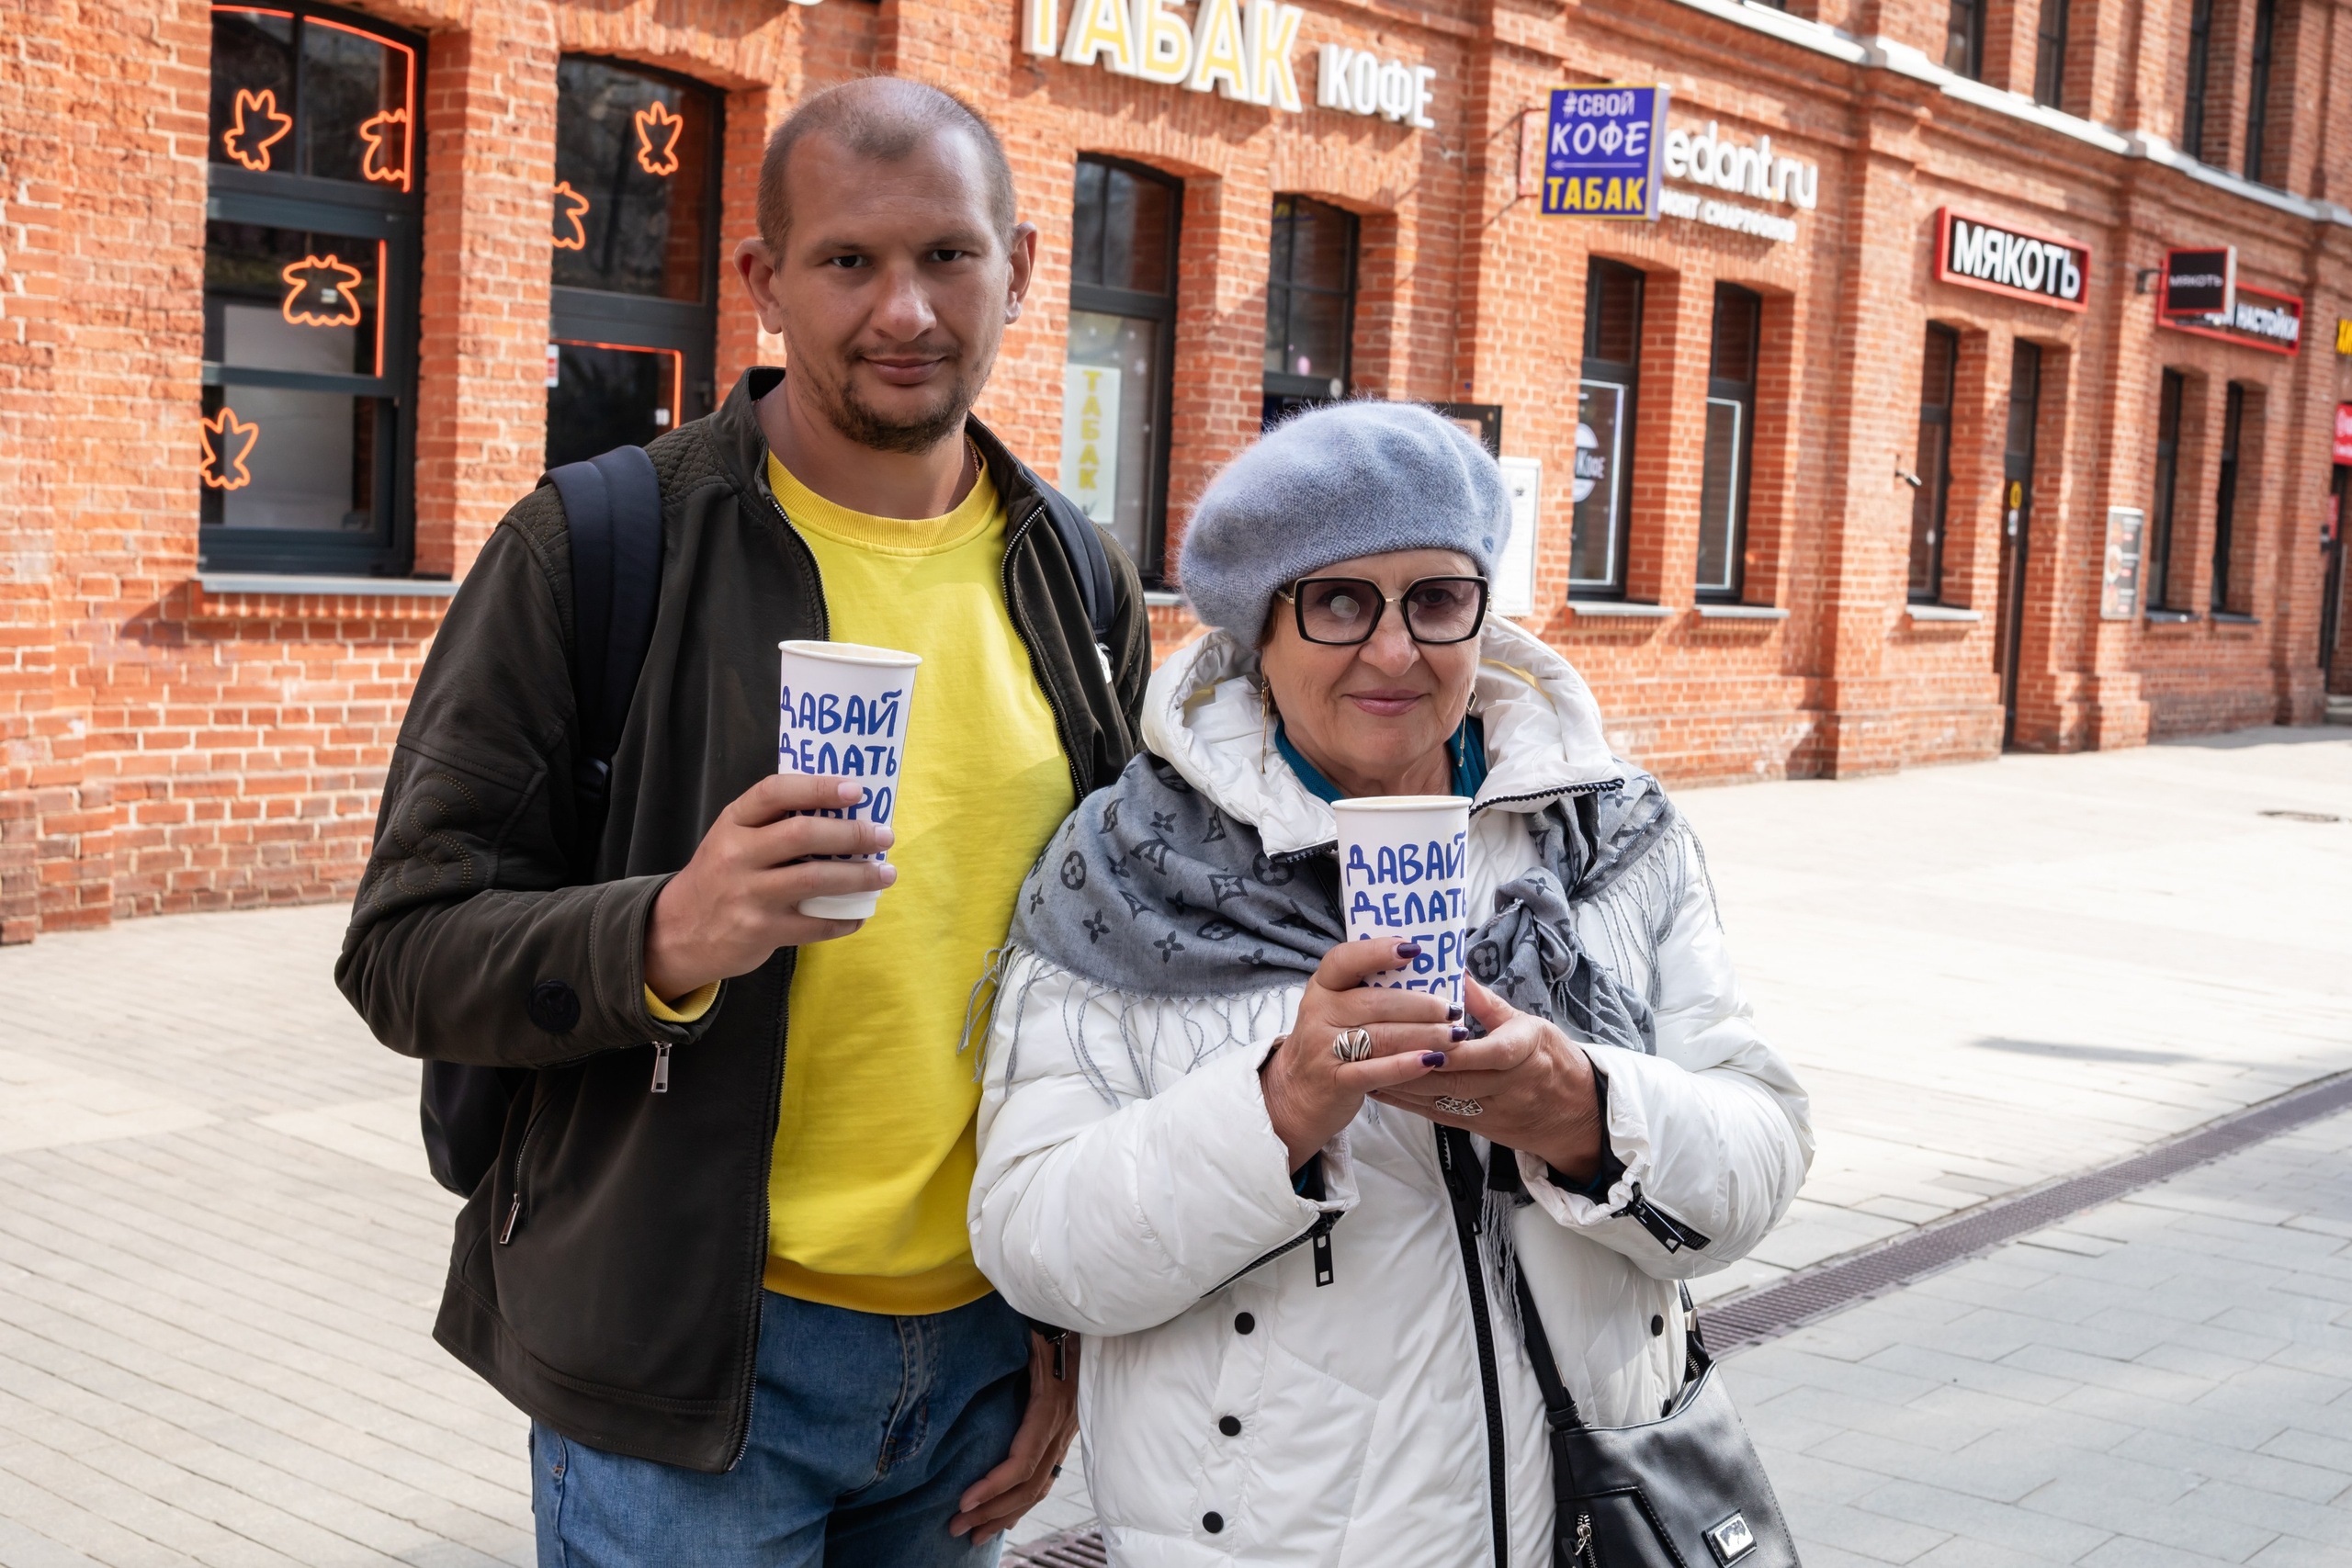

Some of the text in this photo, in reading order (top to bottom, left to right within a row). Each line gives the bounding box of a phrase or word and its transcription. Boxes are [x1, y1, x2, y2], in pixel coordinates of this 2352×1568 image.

[1319, 43, 1436, 129] КОФЕ
[1563, 90, 1635, 118] #СВОЙ
[1551, 119, 1650, 156] КОФЕ
[1546, 176, 1645, 210] ТАБАК
[1952, 220, 2081, 299] МЯКОТЬ
[2168, 274, 2224, 288] МЯКОТЬ
[1078, 369, 1102, 490] ТАБАК
[780, 685, 903, 739] ДАВАЙ
[779, 732, 898, 778] ДЕЛАТЬ
[1346, 829, 1467, 887] ДАВАЙ
[1359, 928, 1466, 975] БРО
